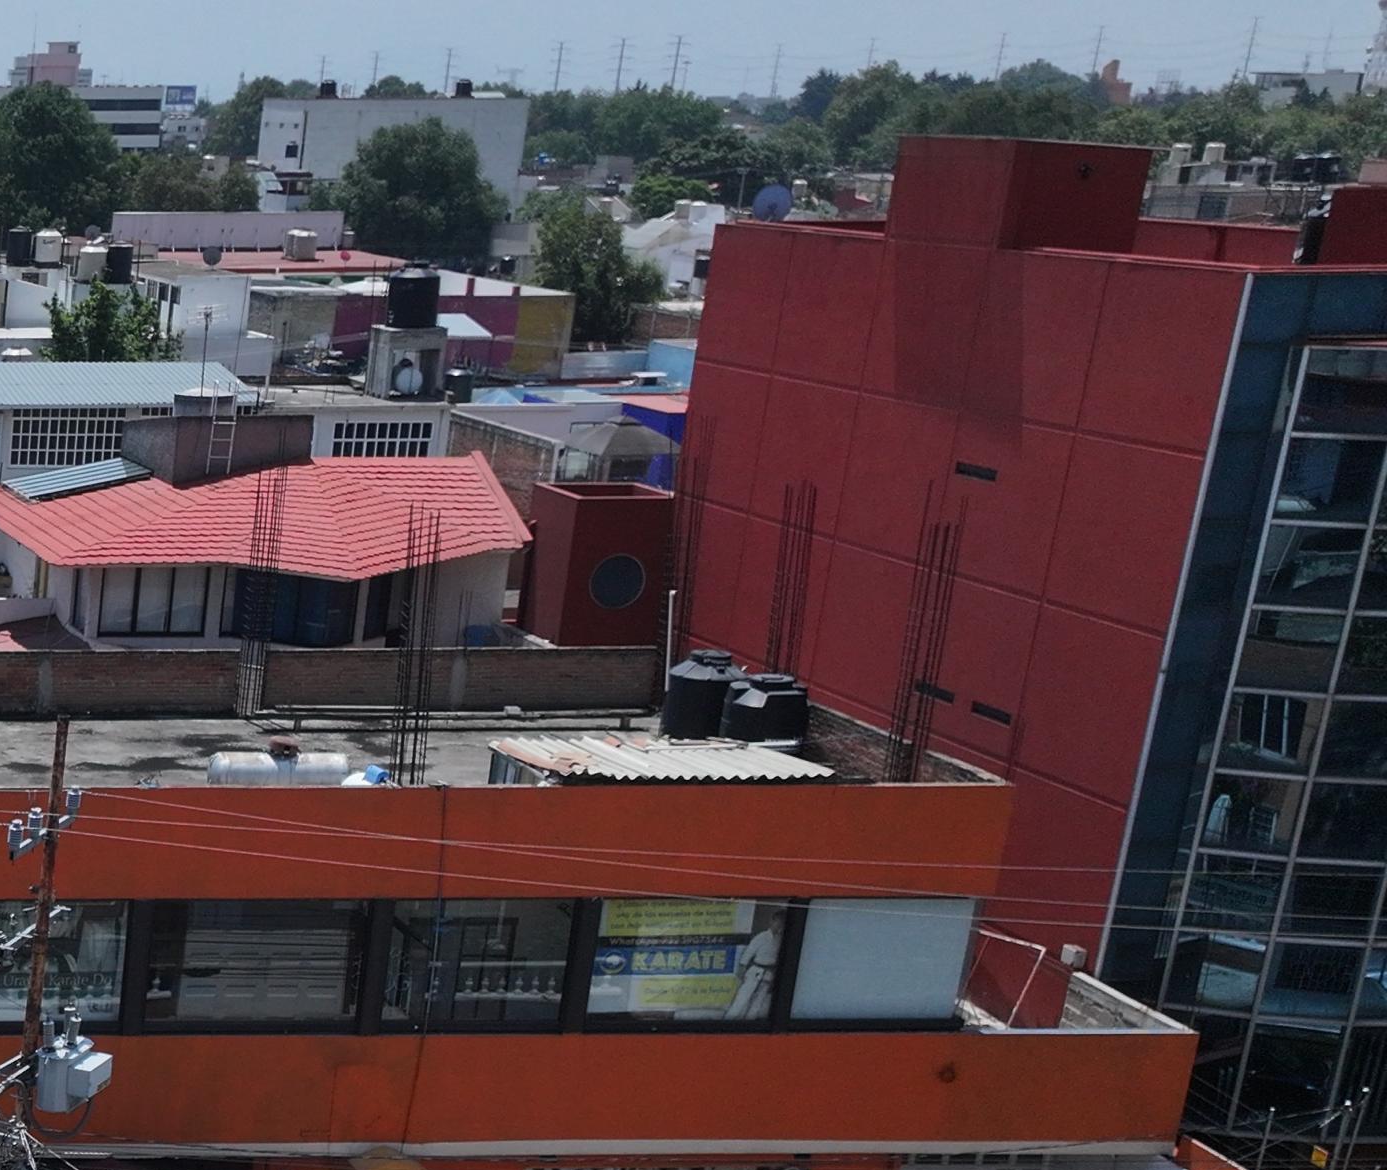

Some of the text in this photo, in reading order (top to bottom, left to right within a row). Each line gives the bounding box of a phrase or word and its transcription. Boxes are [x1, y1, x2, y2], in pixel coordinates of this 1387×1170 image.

[631, 950, 727, 971] KARATE
[49, 973, 89, 986] Karate
[93, 973, 113, 986] Do
